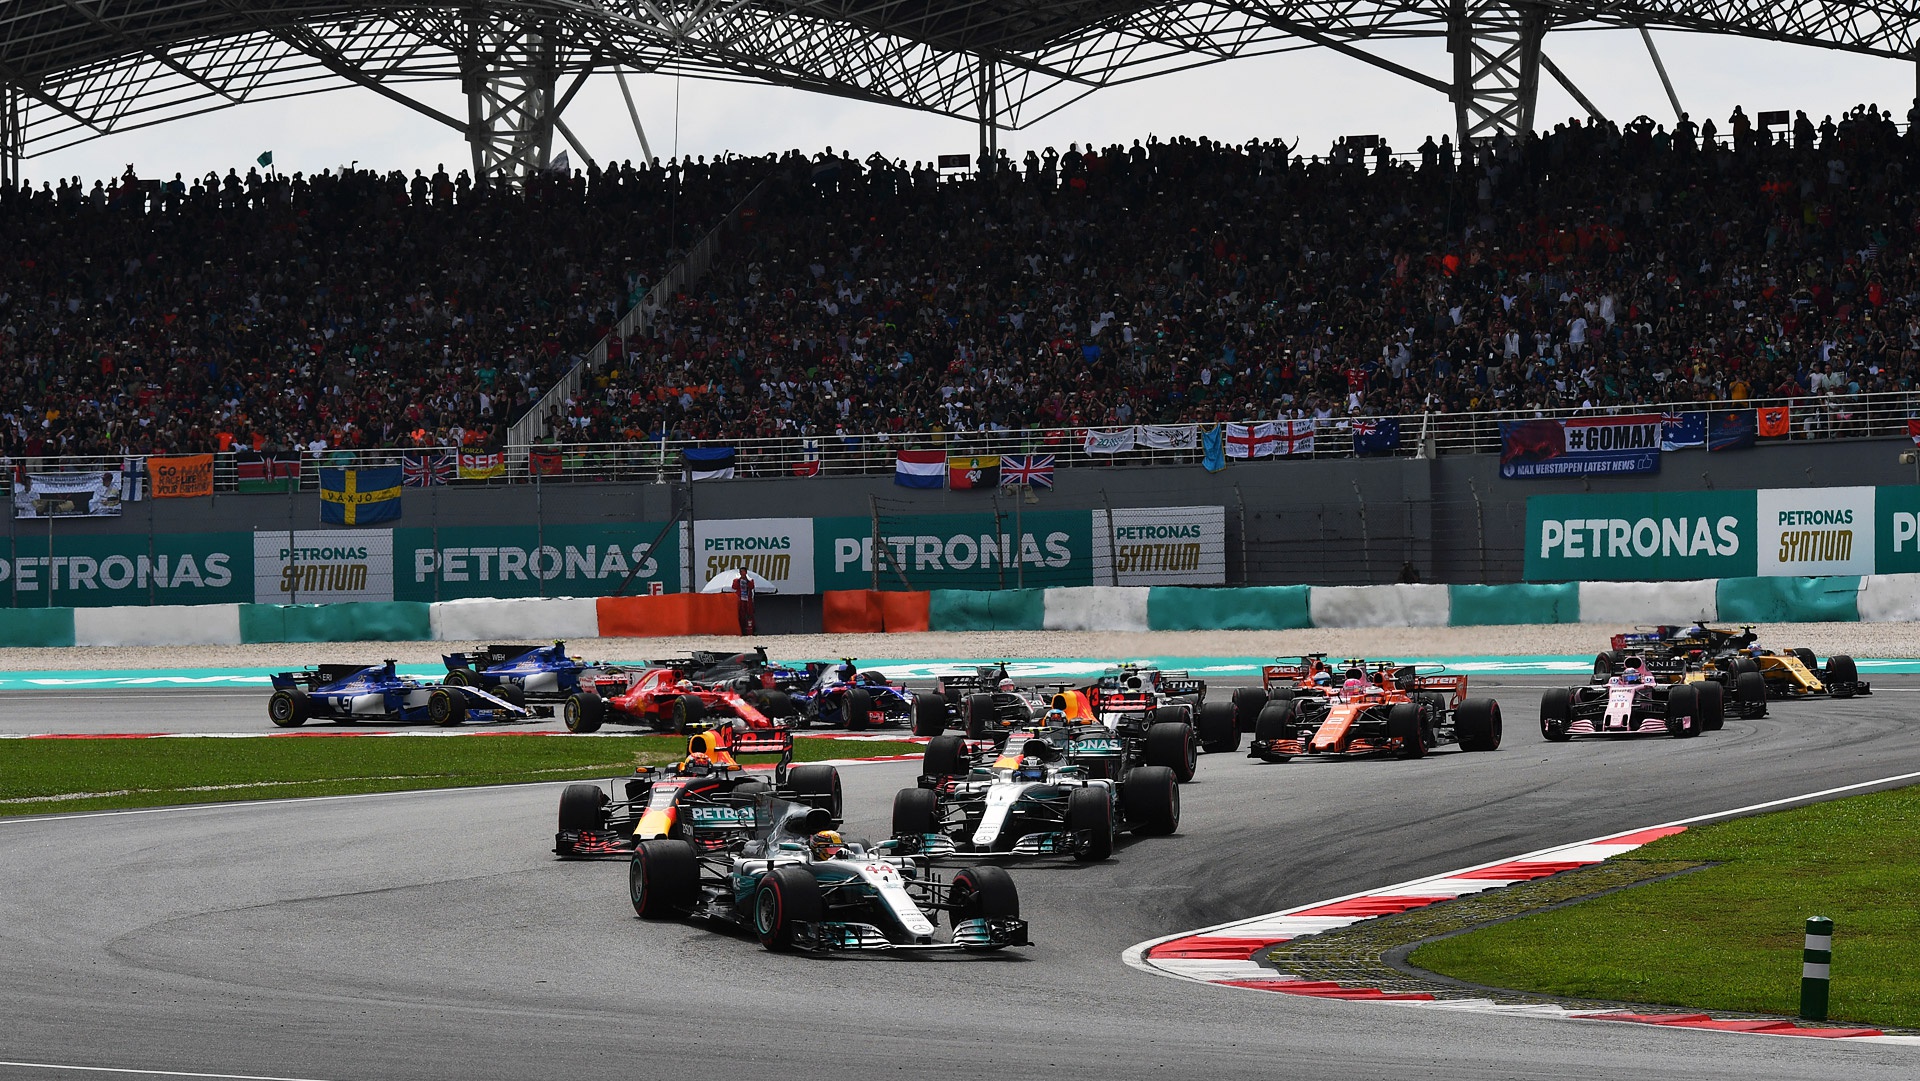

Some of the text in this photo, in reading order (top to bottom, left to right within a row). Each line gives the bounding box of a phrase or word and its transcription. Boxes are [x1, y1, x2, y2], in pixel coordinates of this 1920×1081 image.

[1569, 424, 1656, 451] #GOMAX
[463, 454, 498, 469] SEB
[1517, 460, 1635, 475] MAX VERSTAPPEN LATEST NEWS
[158, 466, 176, 476] GO
[1778, 510, 1853, 526] PETRONAS
[1117, 525, 1201, 540] PETRONAS
[1540, 516, 1739, 559] PETRONAS
[704, 536, 790, 551] PETRONAS
[1778, 530, 1853, 562] SYNTIUM
[279, 547, 367, 561] PETRONAS
[835, 532, 1072, 573] PETRONAS
[1118, 543, 1201, 573] SYNTIUM
[414, 543, 658, 582] PETRONAS
[280, 564, 367, 592] SYNTIUM
[322, 673, 333, 681] ERI
[1069, 739, 1119, 749] RONAS
[866, 865, 893, 874] 44
